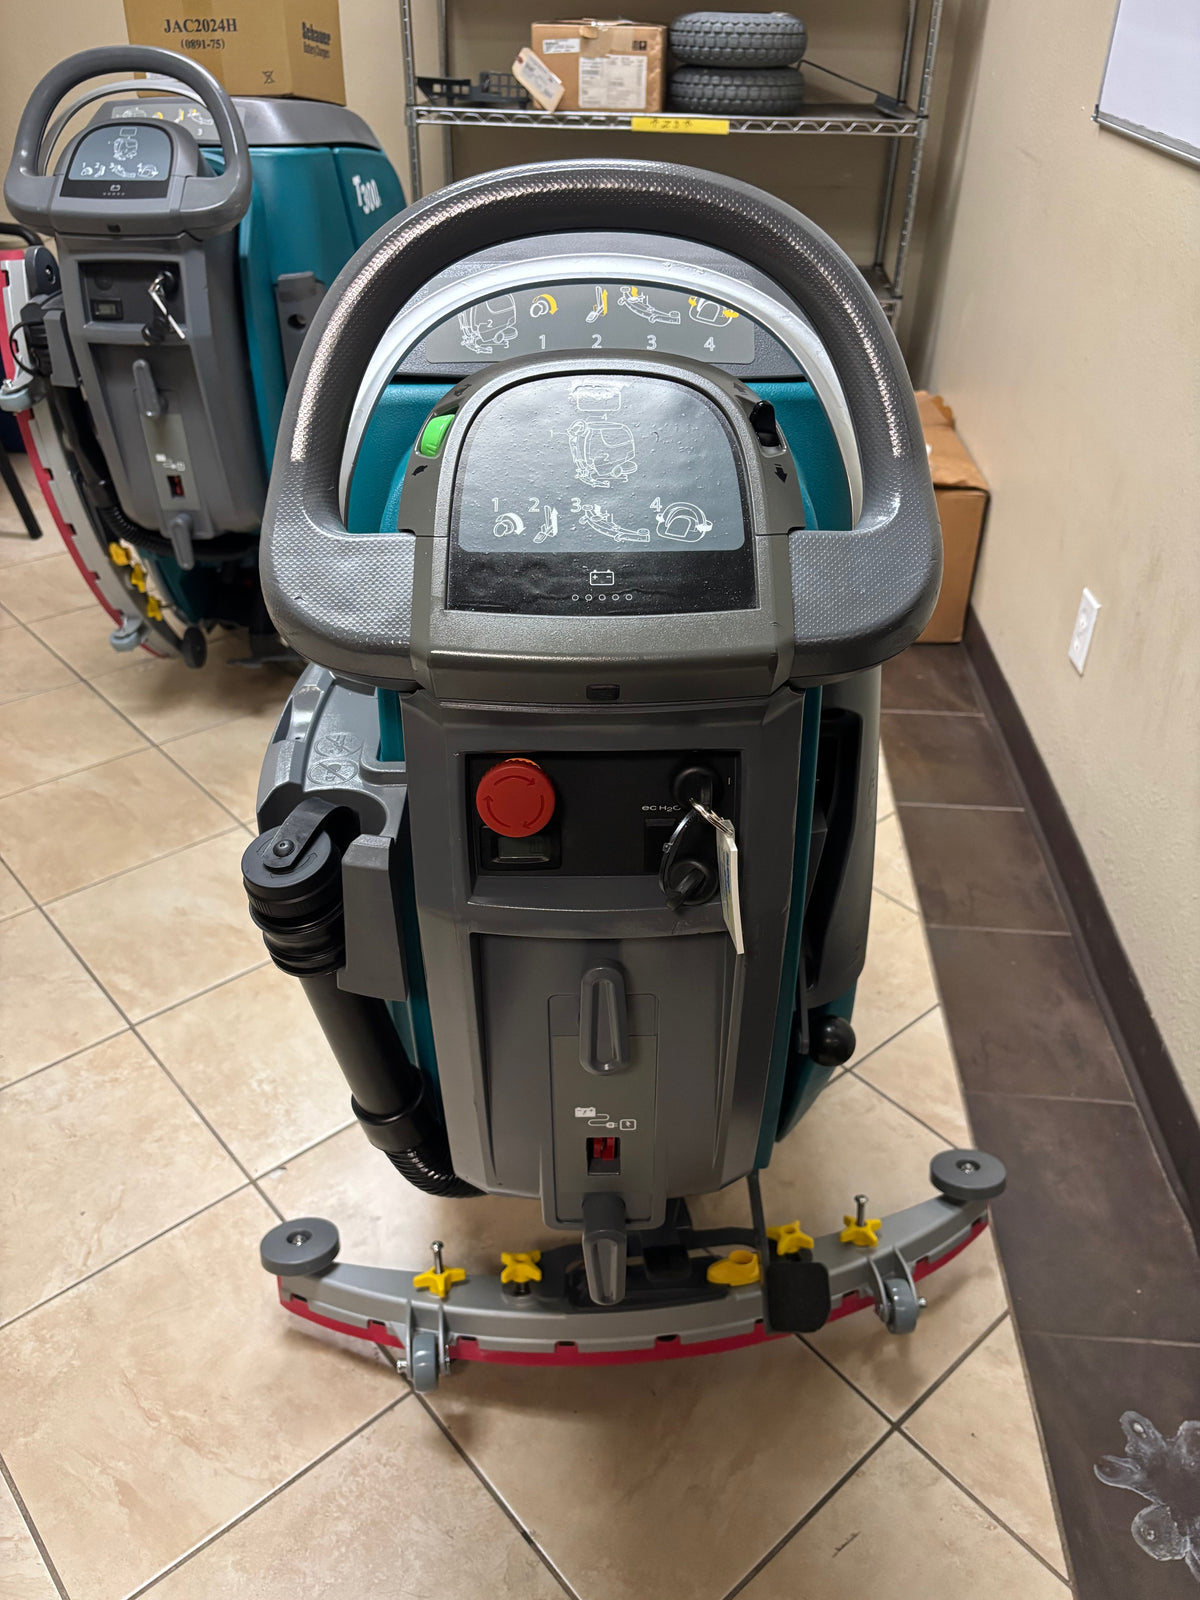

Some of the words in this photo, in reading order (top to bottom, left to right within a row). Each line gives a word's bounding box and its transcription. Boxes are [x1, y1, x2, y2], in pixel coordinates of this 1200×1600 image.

[164, 18, 237, 33] JAC2024H
[180, 39, 225, 50] (0891-75)
[487, 319, 493, 328] 2
[503, 340, 510, 349] 3
[539, 335, 547, 349] 1
[591, 335, 602, 349] 2
[646, 335, 657, 350] 3
[703, 336, 716, 351] 4
[603, 453, 610, 461] 2
[491, 497, 499, 512] 1
[528, 497, 540, 513] 2
[570, 497, 582, 513] 3
[649, 496, 662, 512] 4
